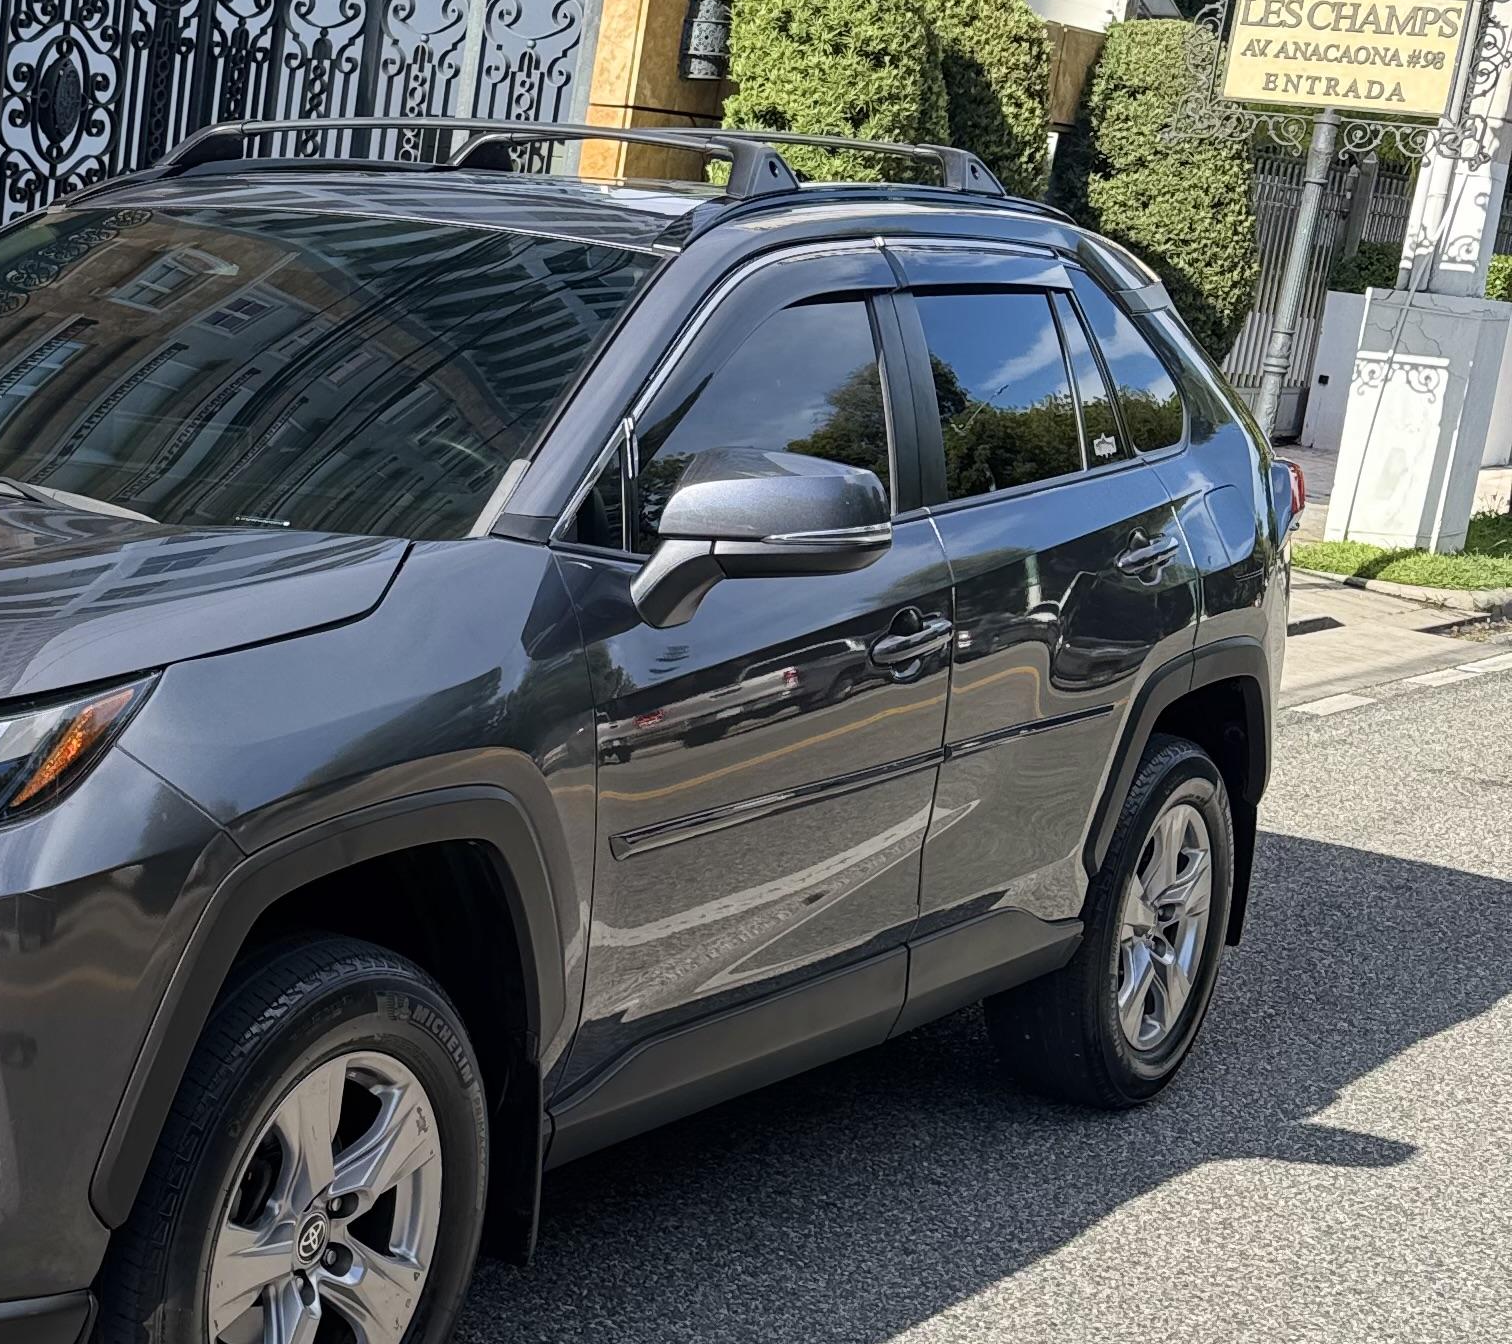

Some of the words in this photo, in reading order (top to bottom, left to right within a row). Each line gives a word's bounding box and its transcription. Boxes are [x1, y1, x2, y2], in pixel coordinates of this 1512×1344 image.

[1307, 0, 1463, 38] CHAMPS
[1273, 40, 1404, 67] ANACAONA
[1406, 49, 1446, 70] #98
[1261, 72, 1406, 103] ENTRADA
[411, 1003, 475, 1084] MICHELIN
